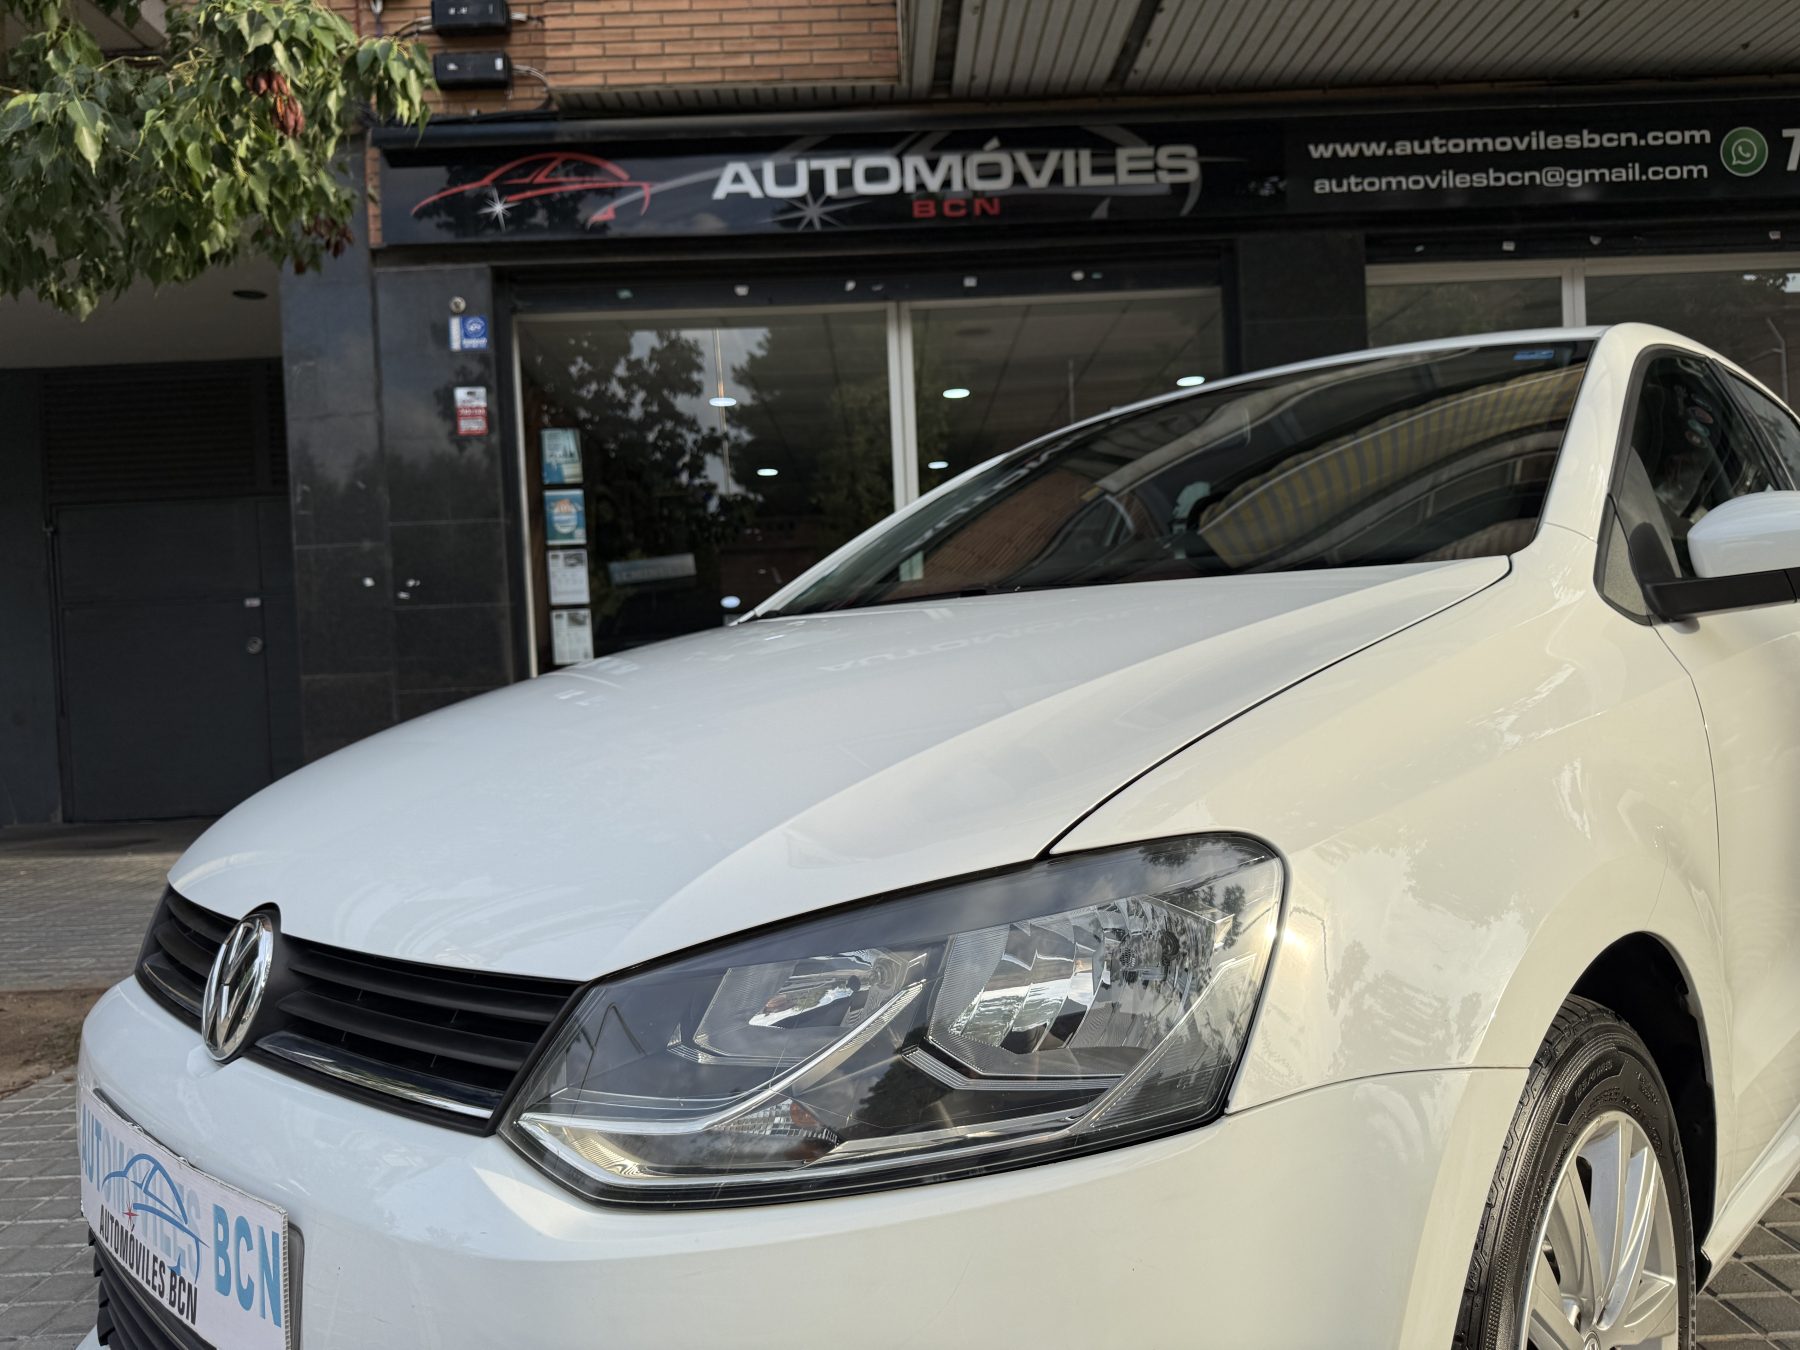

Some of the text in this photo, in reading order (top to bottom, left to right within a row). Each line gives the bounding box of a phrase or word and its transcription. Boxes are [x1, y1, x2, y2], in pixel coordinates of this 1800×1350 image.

[1308, 126, 1711, 159] www.automovilesbcn.com
[712, 138, 1199, 199] AUTOMÓVILES
[1313, 162, 1708, 195] automovilesbcn@gmail.com
[911, 198, 1001, 219] BCN
[99, 1204, 198, 1326] AUTOMÓVILES BCN
[212, 1203, 283, 1328] BCN
